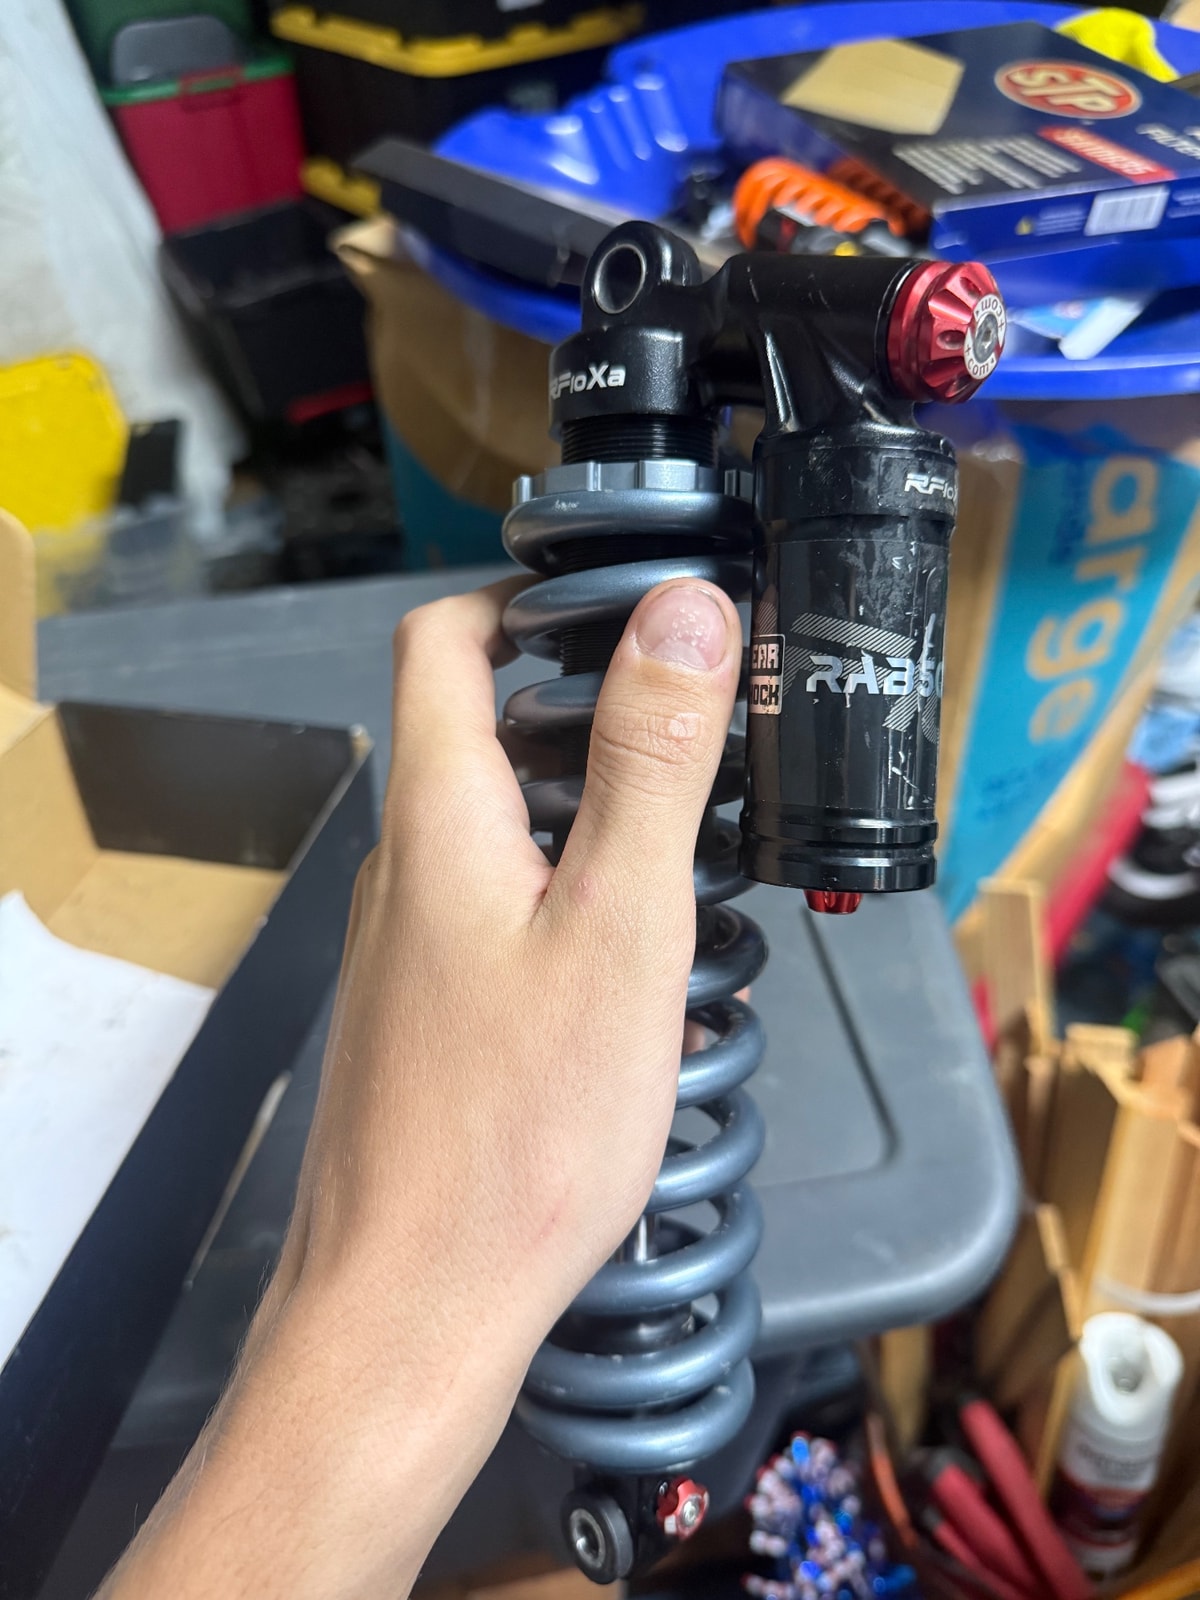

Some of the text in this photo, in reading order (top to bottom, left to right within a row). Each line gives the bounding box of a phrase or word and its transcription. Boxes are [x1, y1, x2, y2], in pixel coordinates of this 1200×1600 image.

[1006, 68, 1124, 113] STP
[967, 358, 990, 377] com
[751, 684, 779, 706] OCK
